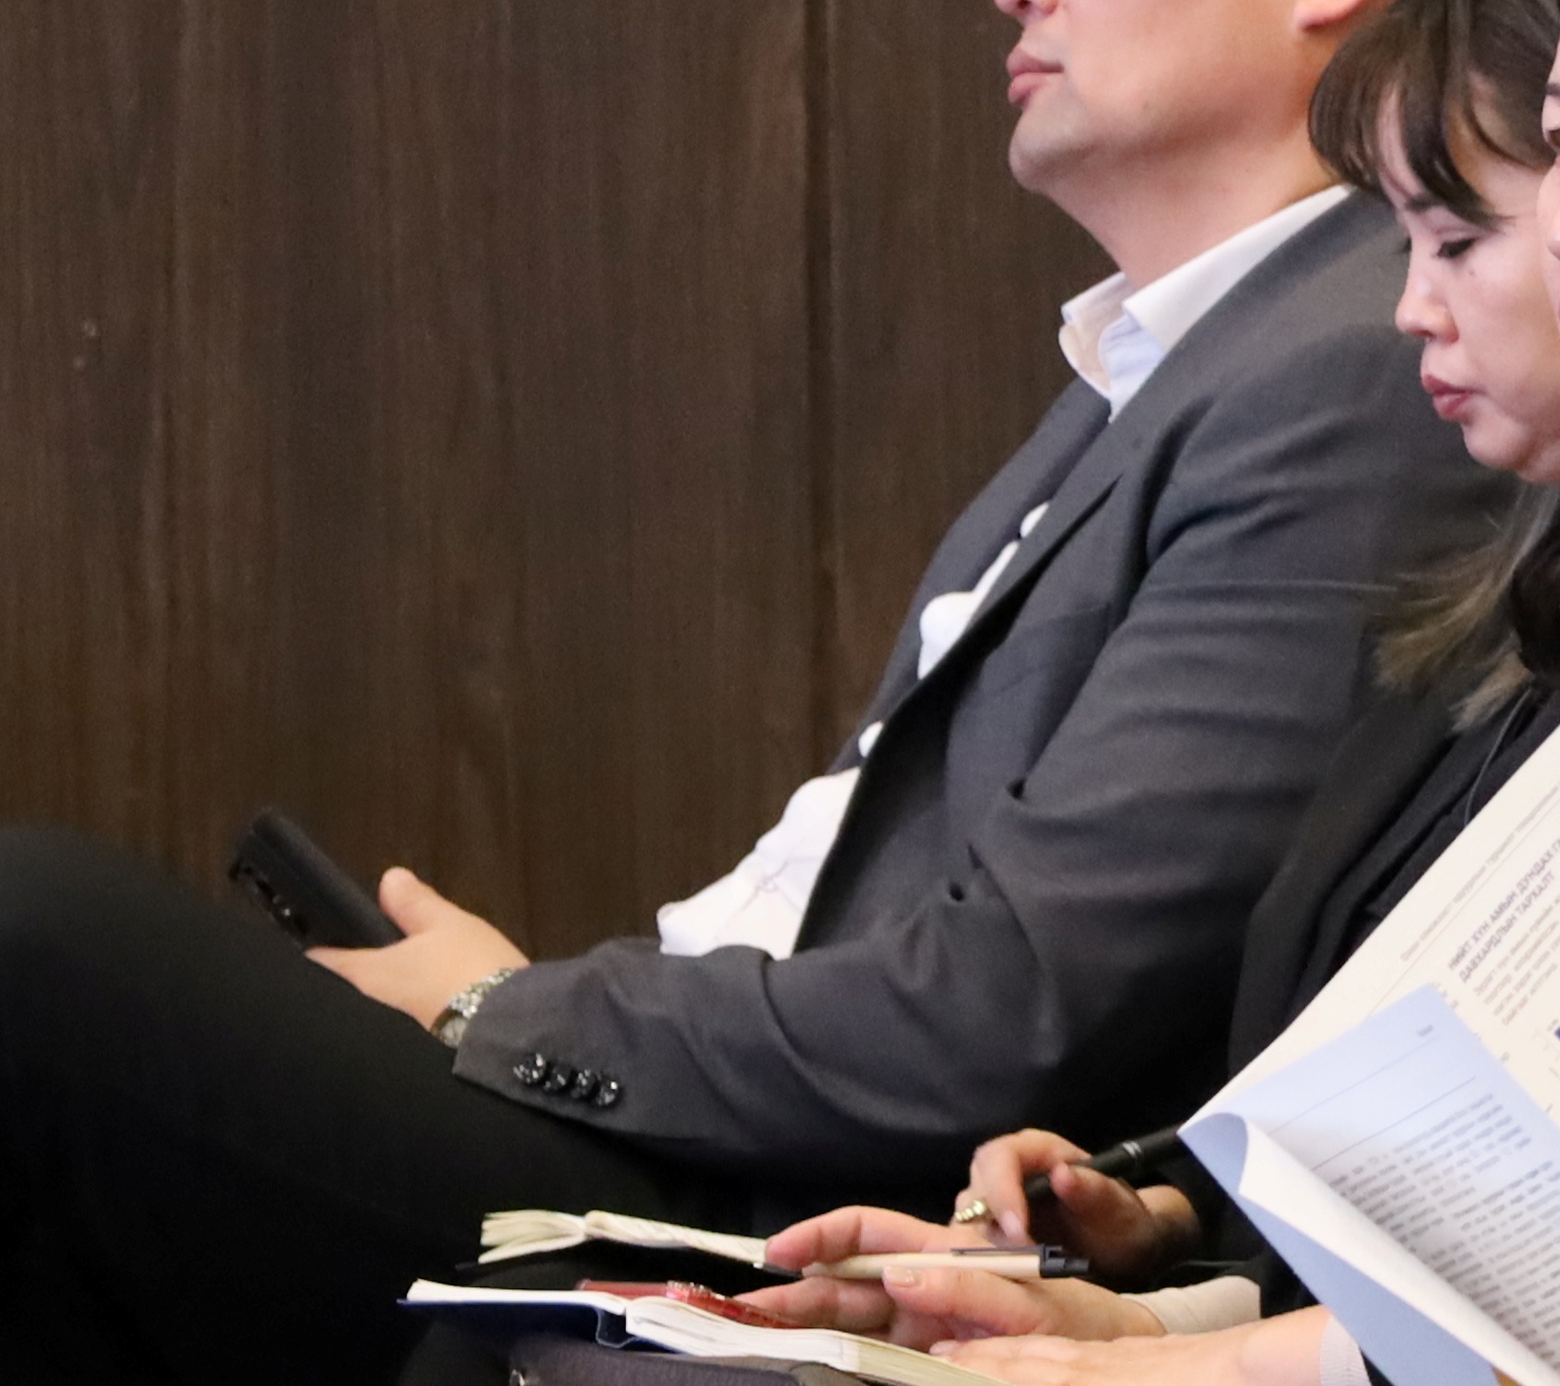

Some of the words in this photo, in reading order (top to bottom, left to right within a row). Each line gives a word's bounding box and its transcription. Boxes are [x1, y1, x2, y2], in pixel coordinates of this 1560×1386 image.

[1514, 849, 1555, 893] ДУНДАХ
[1456, 913, 1518, 982] ДАВХАРДЛЫН
[1515, 870, 1556, 916] ТАРХАЛТ
